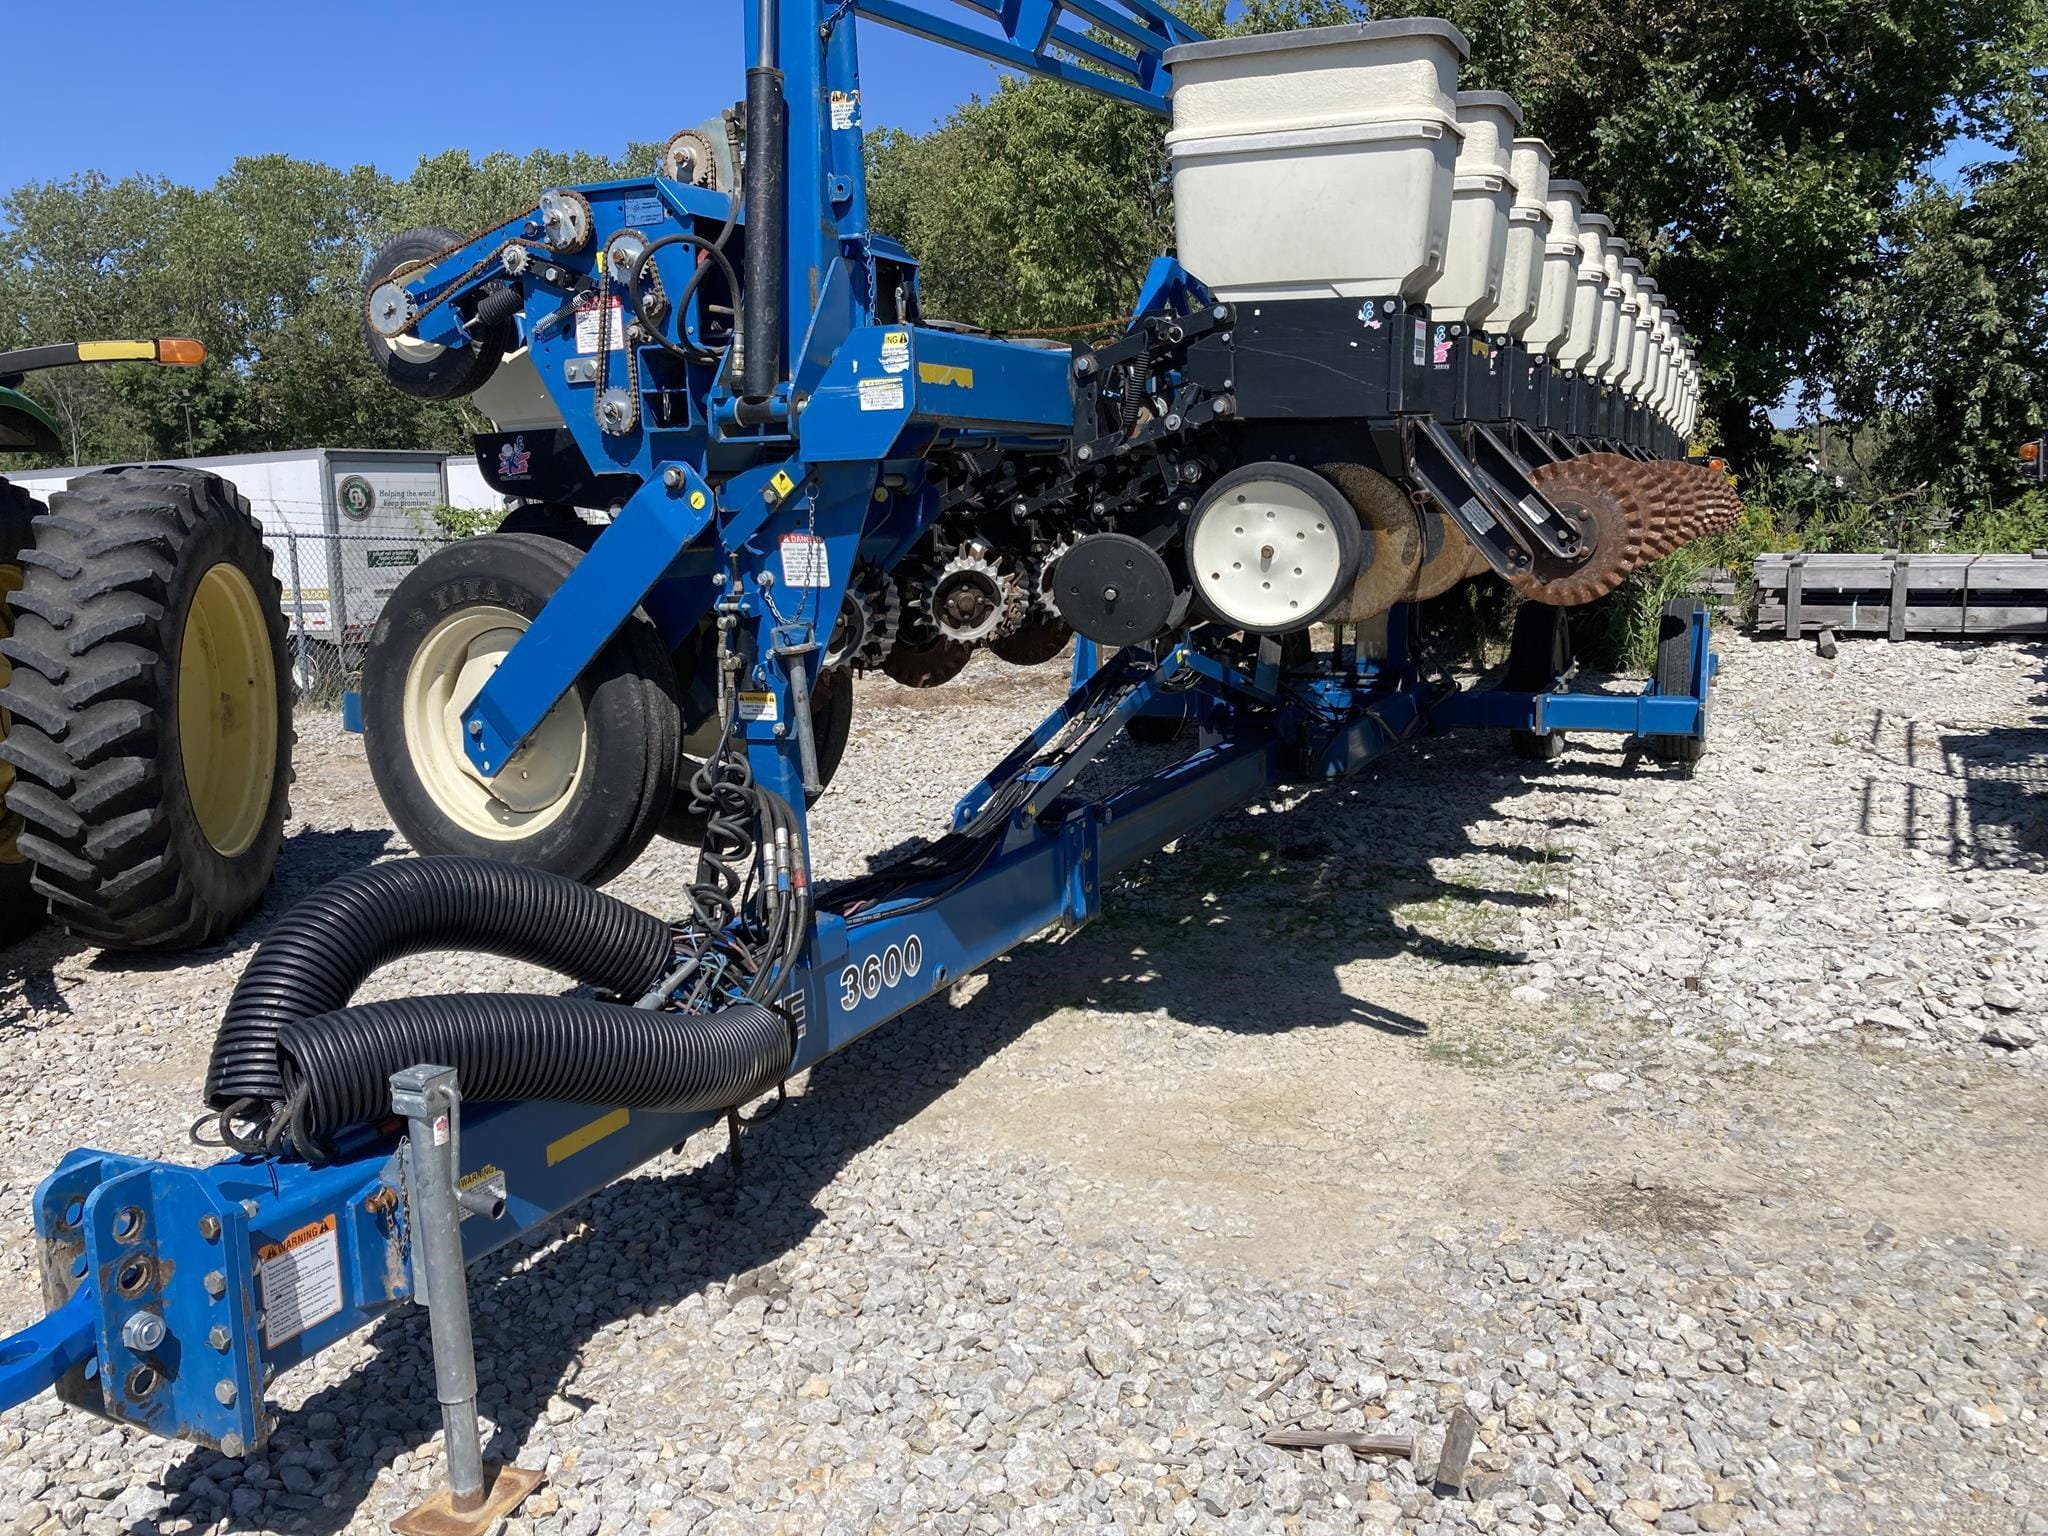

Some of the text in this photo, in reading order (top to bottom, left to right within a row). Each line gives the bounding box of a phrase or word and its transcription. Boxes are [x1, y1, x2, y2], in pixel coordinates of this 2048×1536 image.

[585, 296, 618, 311] DAER
[379, 489, 436, 498] Helping the world
[431, 578, 531, 613] TITAN
[840, 934, 922, 1011] 3600
[278, 1227, 318, 1253] WARNING
